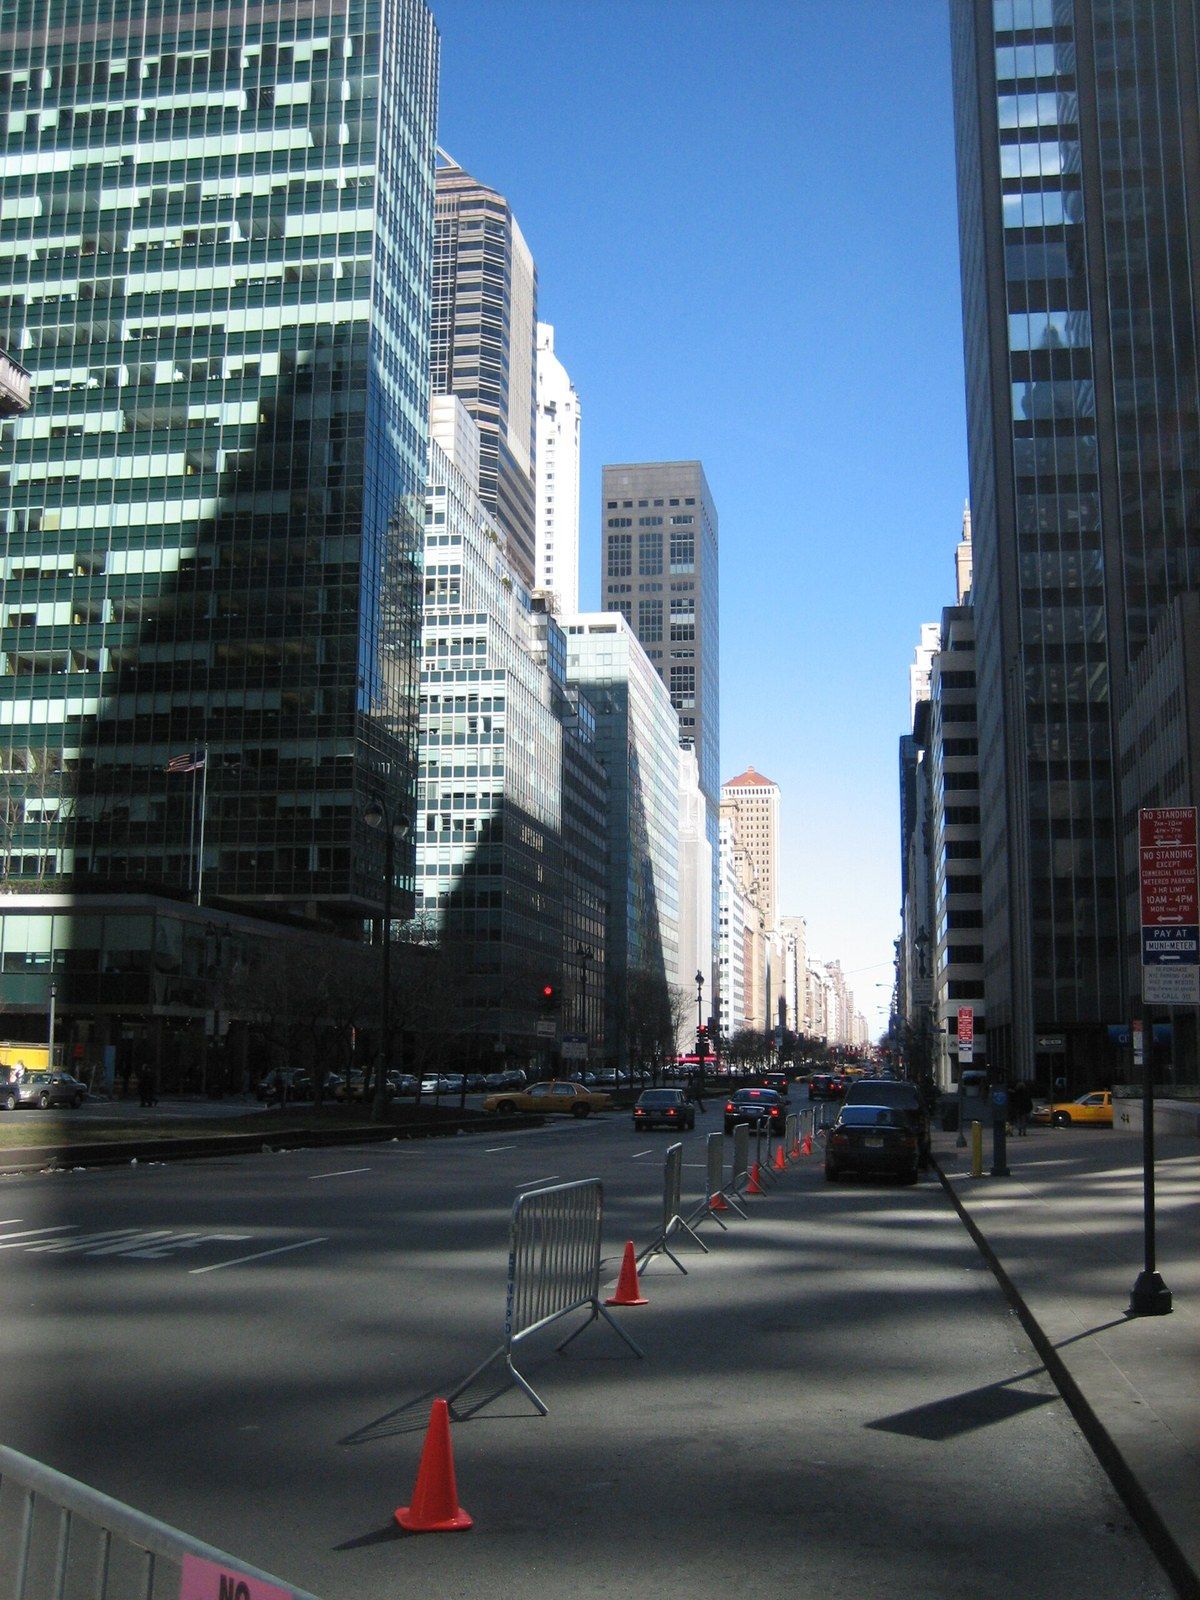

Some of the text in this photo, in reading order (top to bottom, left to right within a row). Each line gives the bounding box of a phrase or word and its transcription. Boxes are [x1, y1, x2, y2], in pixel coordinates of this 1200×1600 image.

[1143, 810, 1192, 819] NO STANDING
[1143, 850, 1192, 859] NO STANDING
[1156, 860, 1180, 868] EXCEPT
[1146, 896, 1167, 904] 10AM
[1175, 895, 1193, 903] 4PM
[1154, 929, 1187, 938] PAY AT
[1148, 941, 1193, 950] MUNI-METER
[218, 1573, 251, 1600] NO
